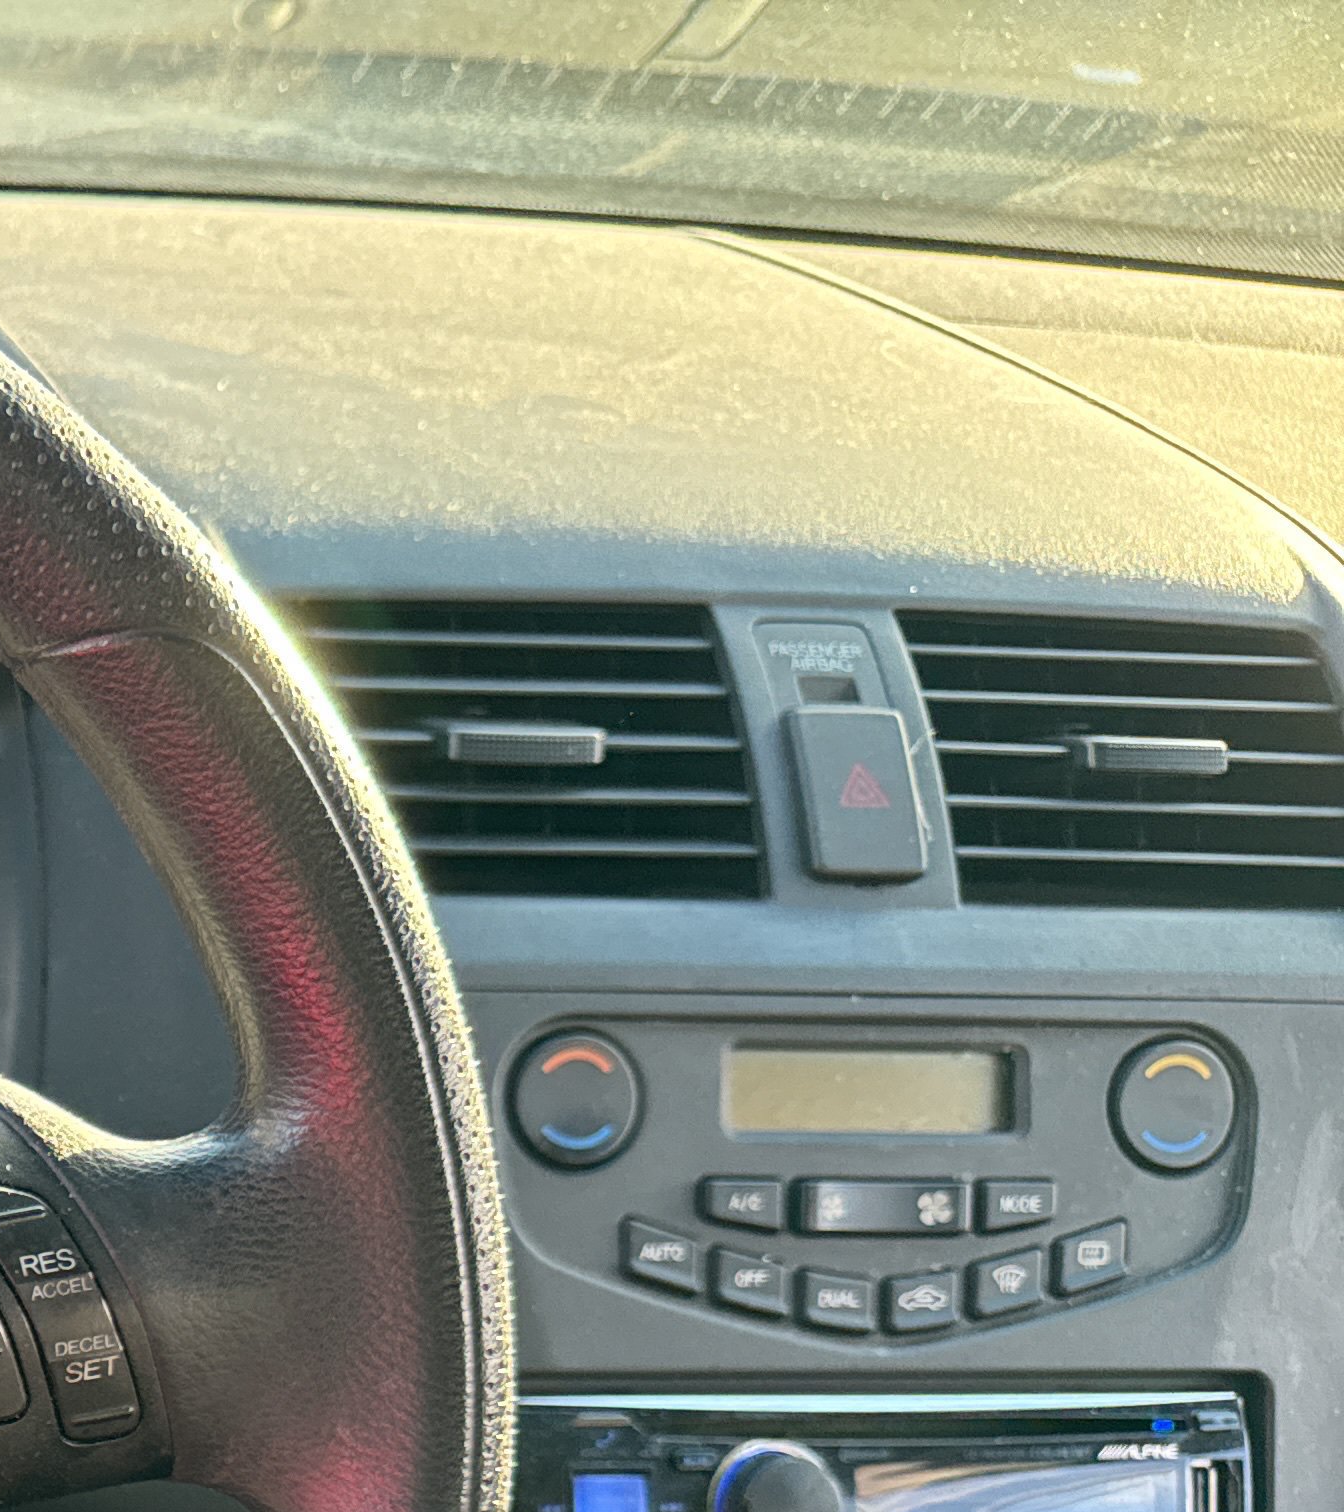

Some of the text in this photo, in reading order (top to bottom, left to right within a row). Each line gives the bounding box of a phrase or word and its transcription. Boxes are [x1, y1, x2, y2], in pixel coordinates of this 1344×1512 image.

[998, 1193, 1043, 1215] MODE
[18, 1248, 78, 1278] RES
[639, 1241, 689, 1264] AUTO
[30, 1278, 94, 1301] ACCEL
[817, 1287, 863, 1310] DUAL
[54, 1333, 116, 1358] DECEL
[64, 1356, 120, 1384] SET
